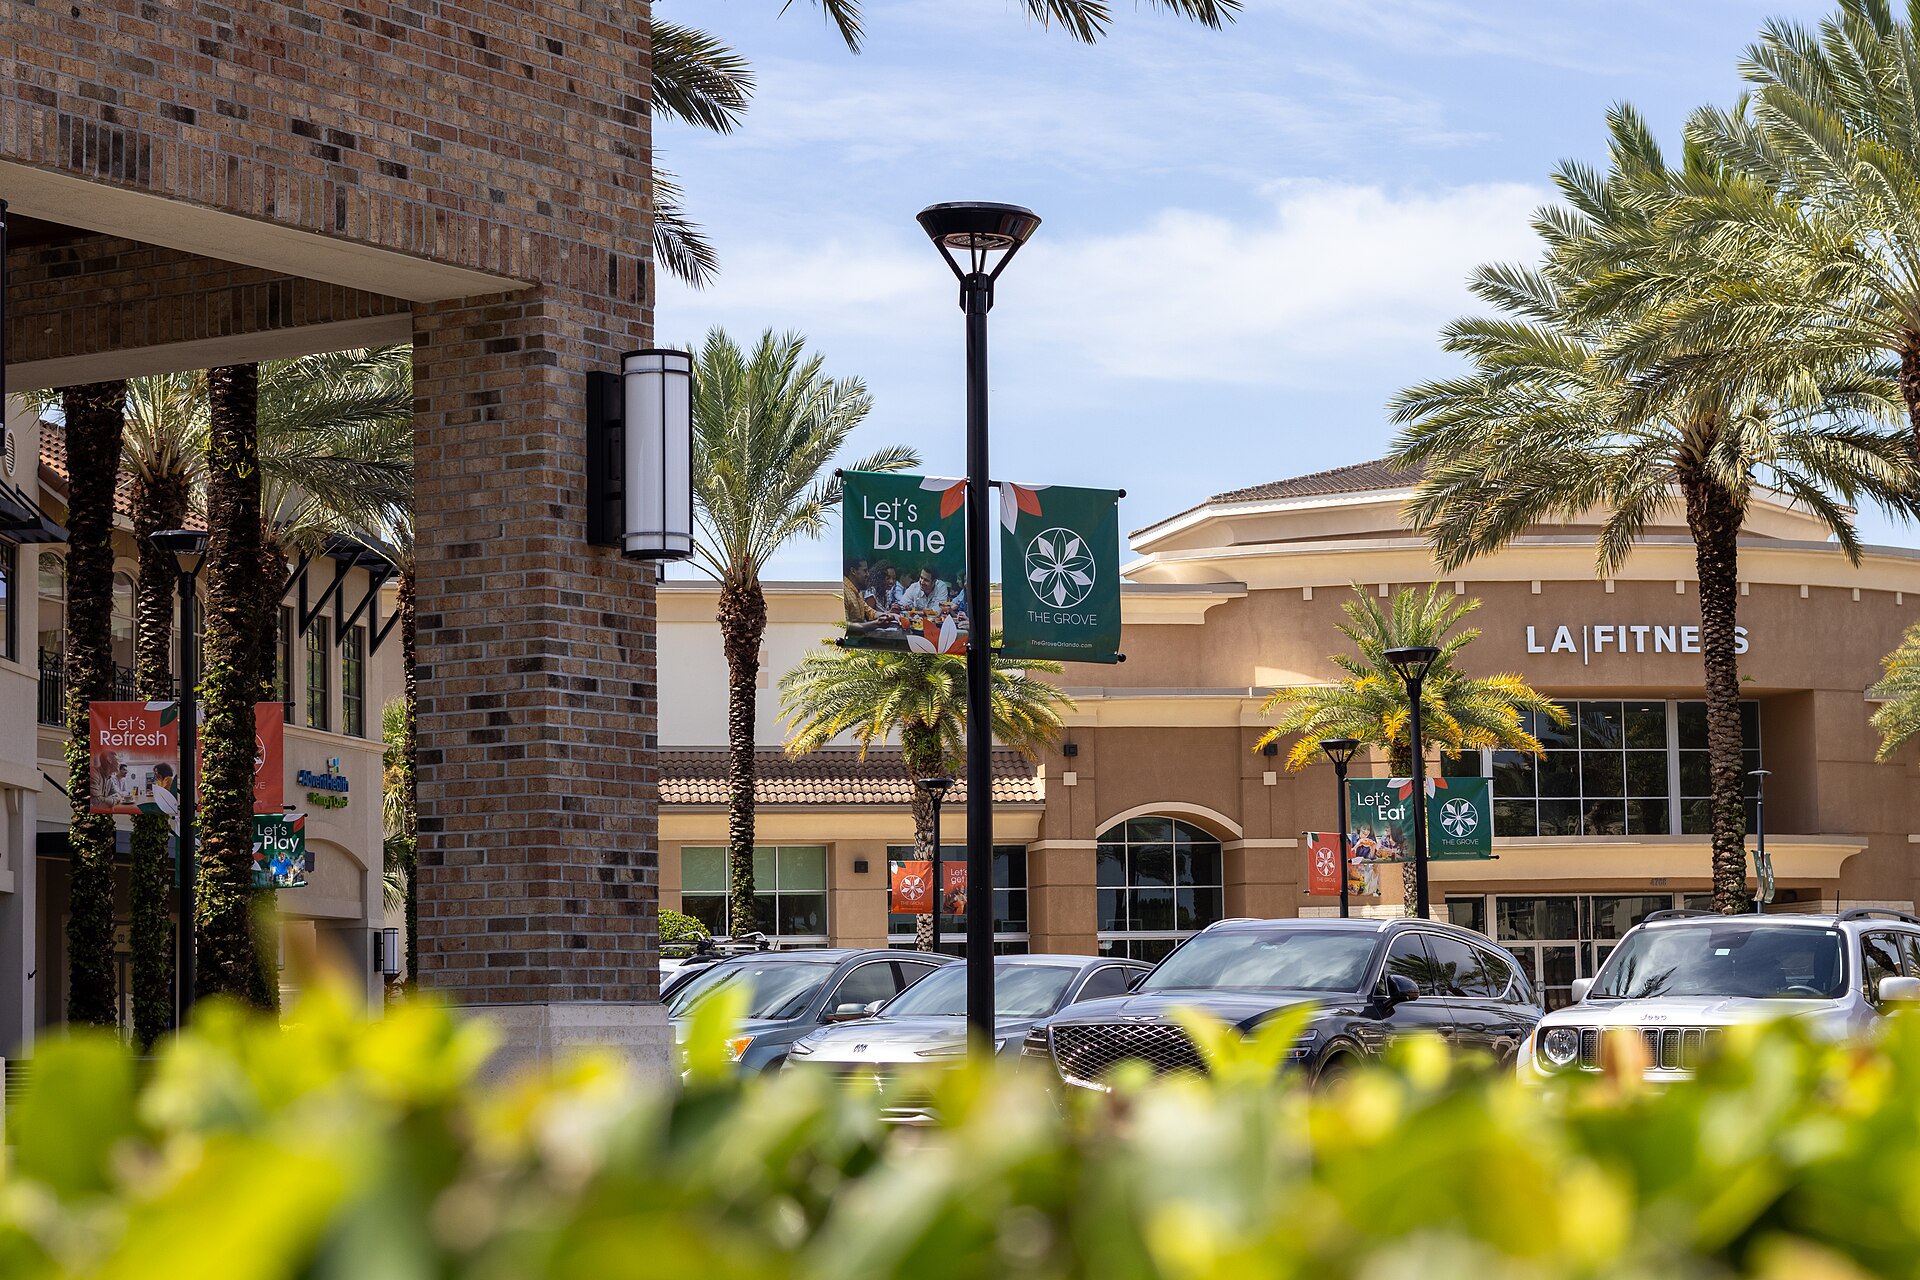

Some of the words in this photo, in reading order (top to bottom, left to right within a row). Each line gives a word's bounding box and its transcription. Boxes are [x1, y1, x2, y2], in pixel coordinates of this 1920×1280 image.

[863, 495, 918, 522] Let's
[873, 520, 945, 553] Dine
[1027, 610, 1051, 624] THE
[1053, 612, 1098, 626] GROVE
[1031, 639, 1093, 648] TheGroveOrlando.com
[1526, 625, 1577, 653] LA
[1593, 625, 1749, 655] FITNES
[109, 716, 146, 731] Let's
[100, 730, 168, 746] Refresh
[1357, 792, 1391, 806] Let's
[1378, 804, 1406, 821] Eat
[257, 824, 288, 836] Let's
[263, 836, 300, 852] Play
